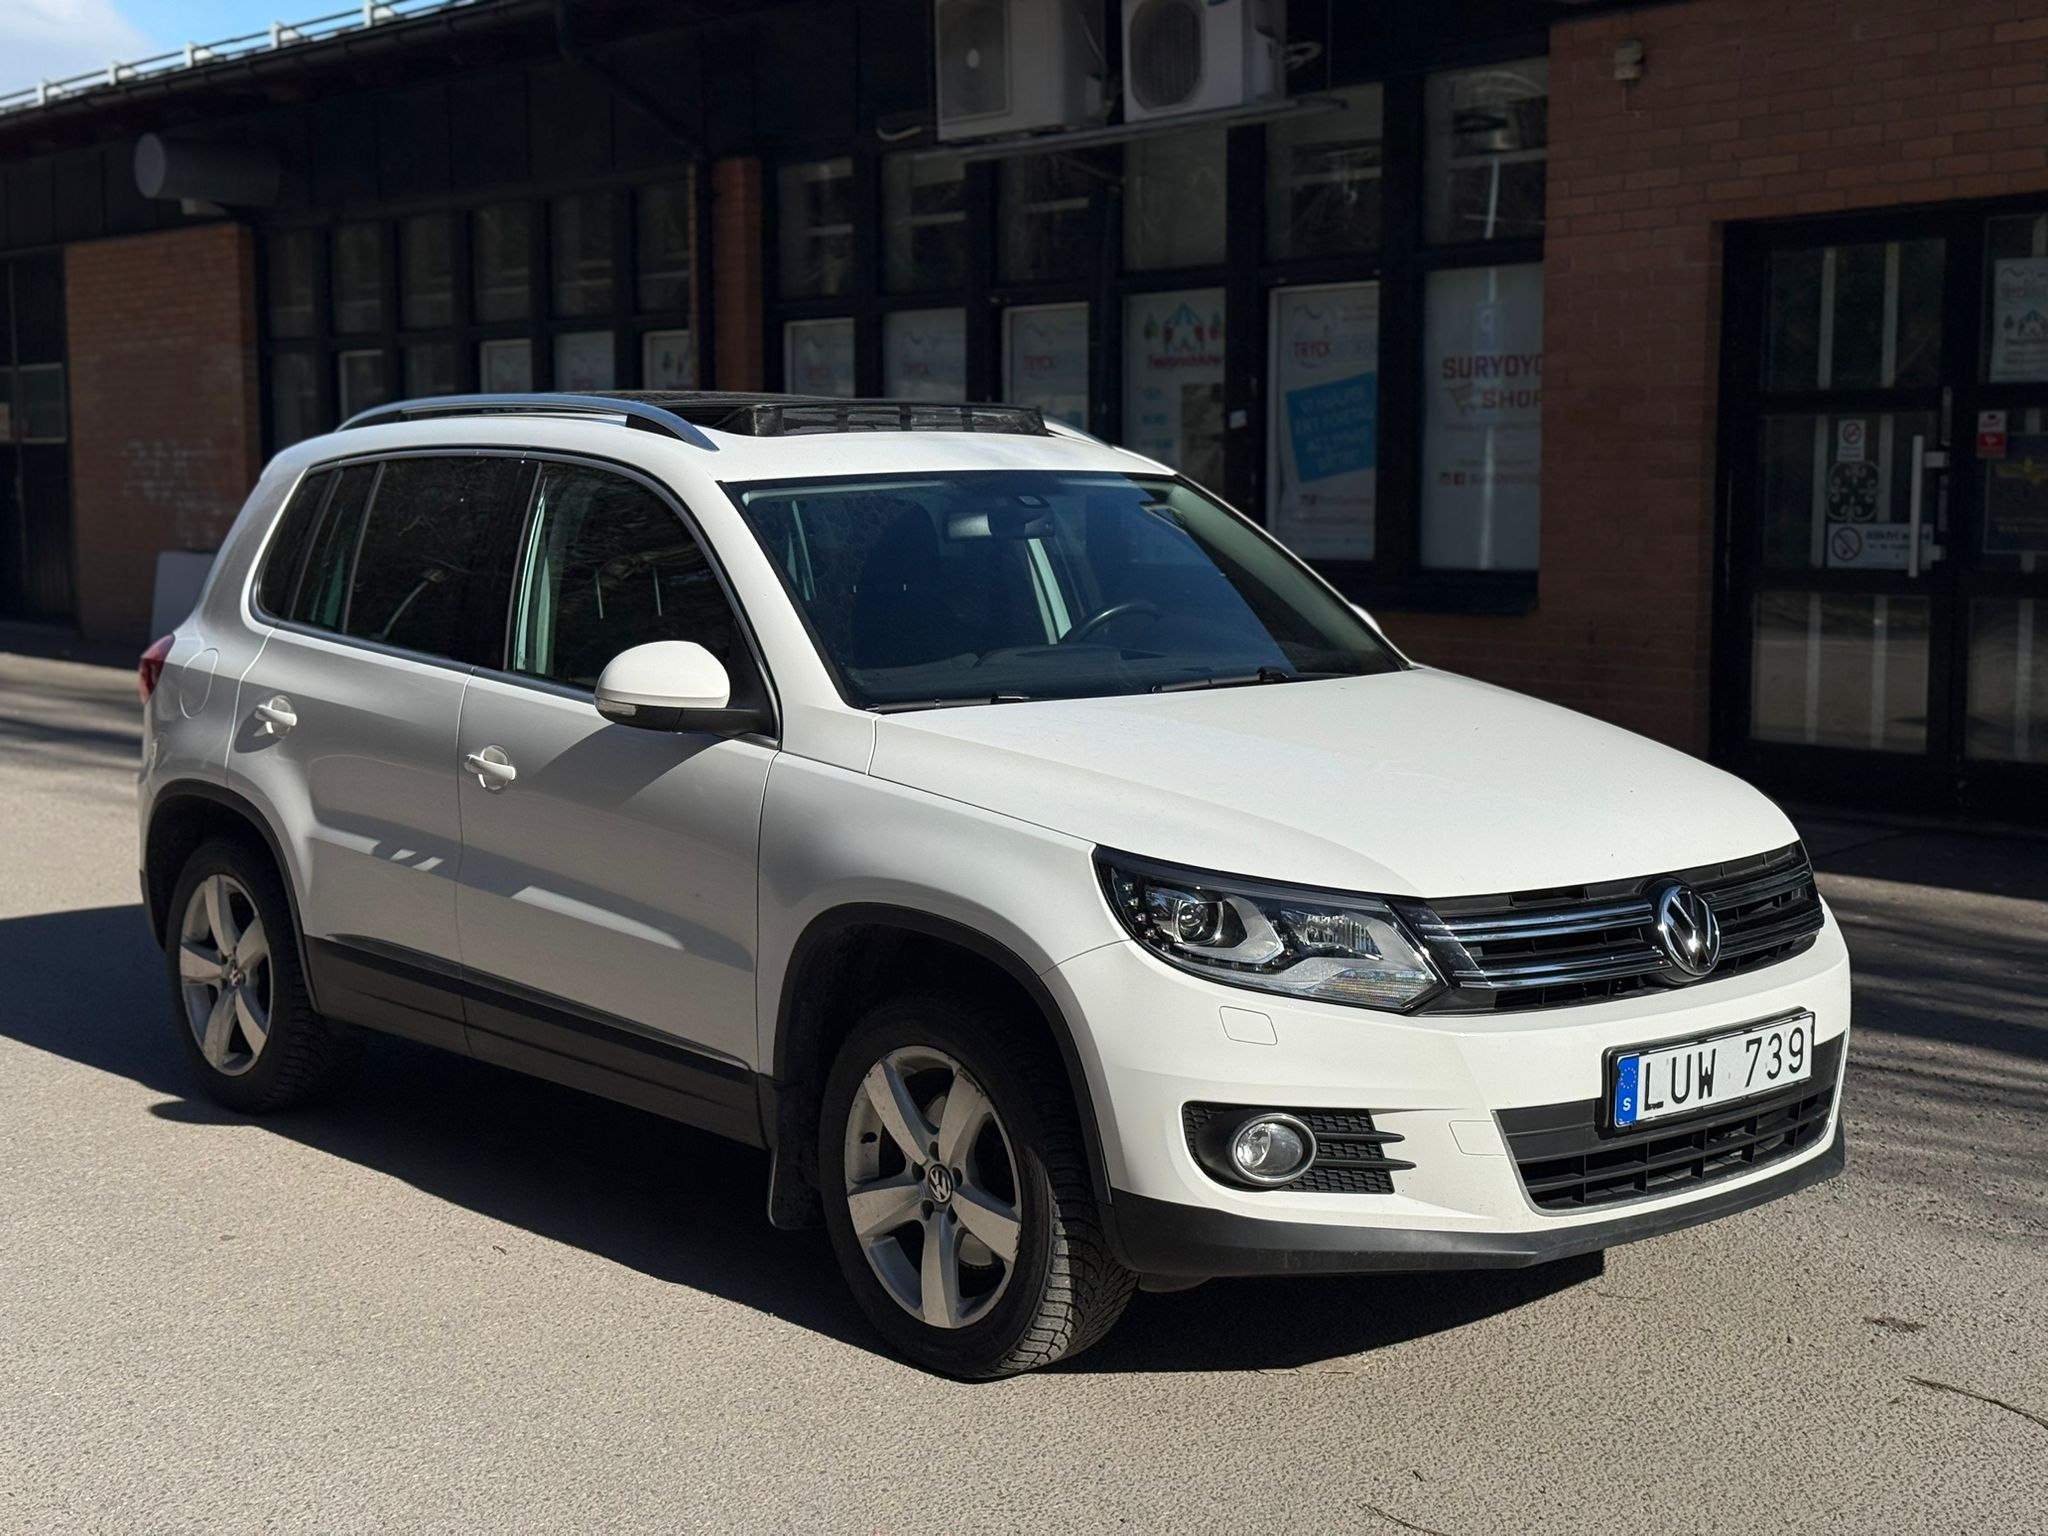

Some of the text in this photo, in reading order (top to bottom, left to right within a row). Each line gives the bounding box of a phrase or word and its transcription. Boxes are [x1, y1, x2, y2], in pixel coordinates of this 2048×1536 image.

[1644, 1027, 1805, 1112] LUW 739
[1622, 1097, 1632, 1111] S
